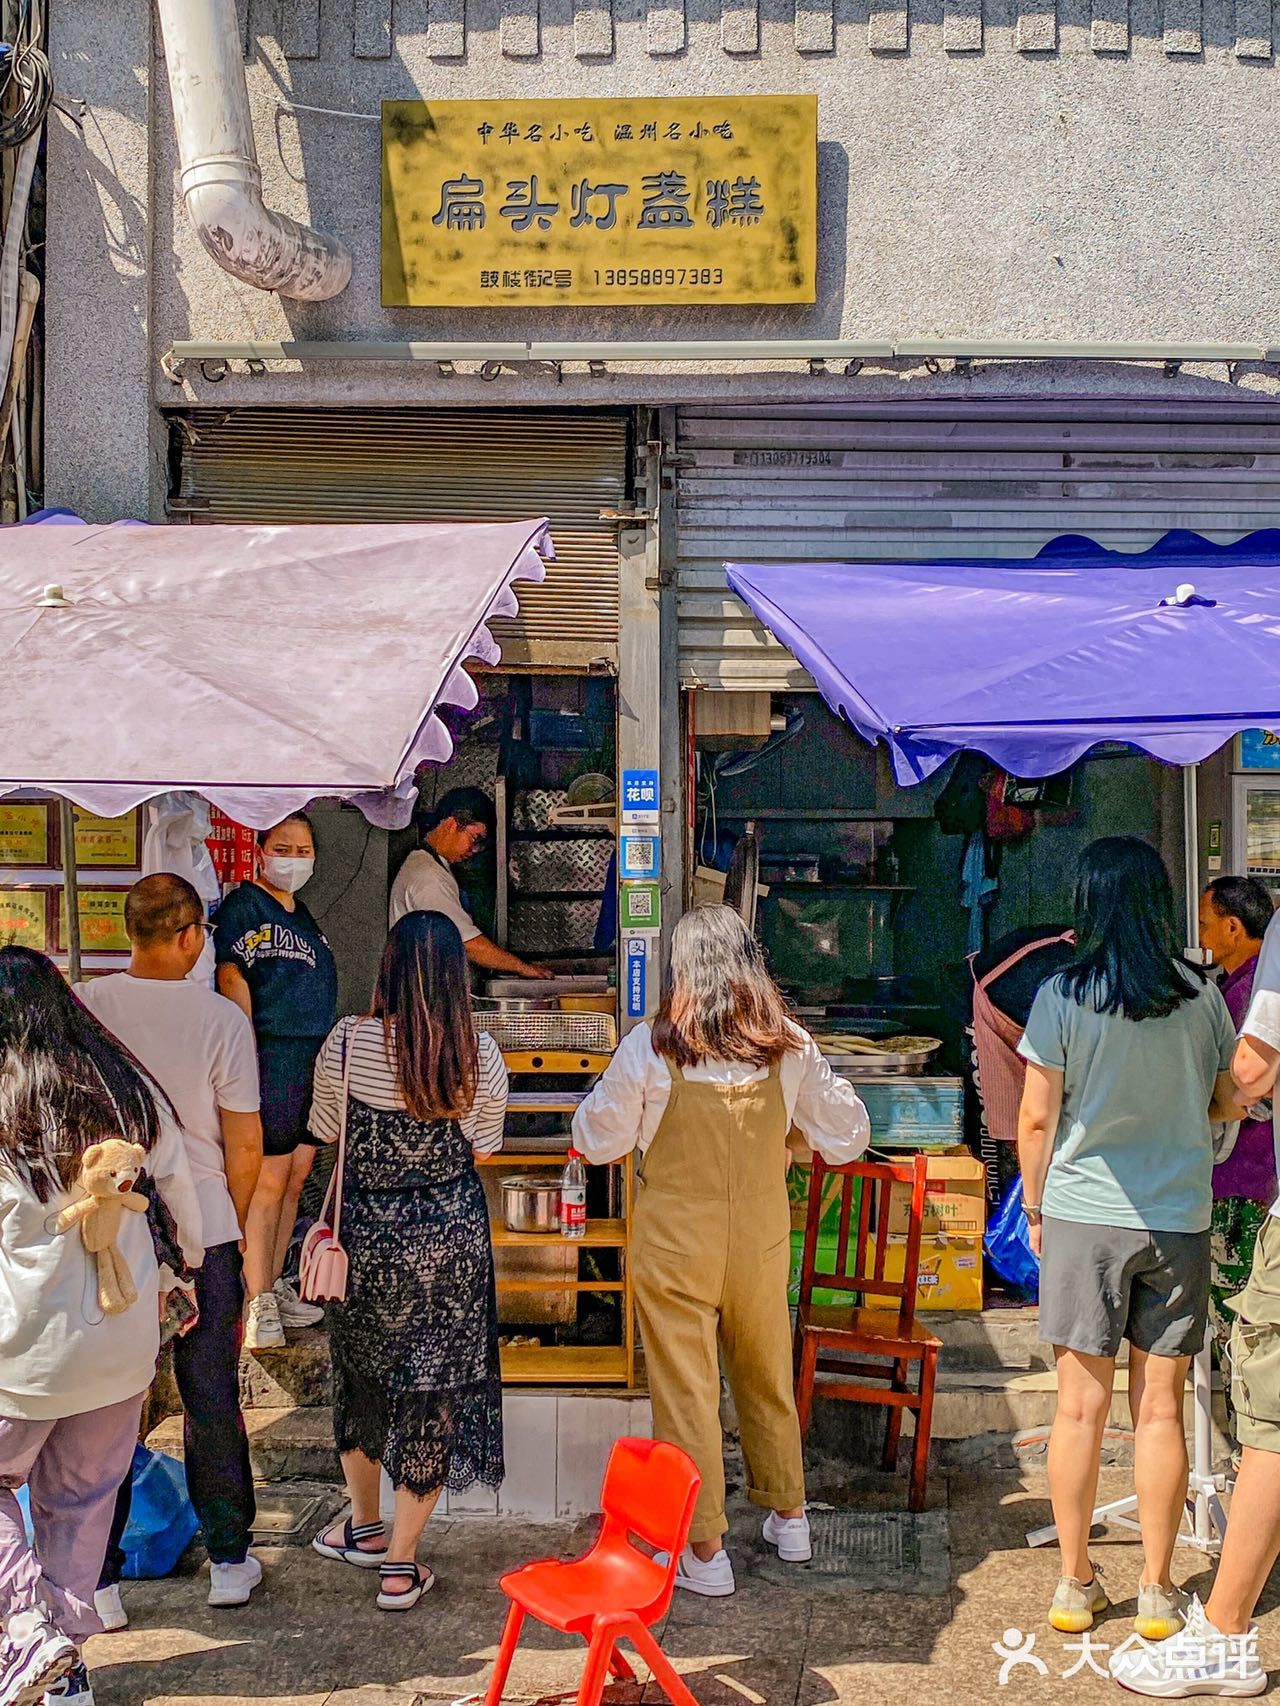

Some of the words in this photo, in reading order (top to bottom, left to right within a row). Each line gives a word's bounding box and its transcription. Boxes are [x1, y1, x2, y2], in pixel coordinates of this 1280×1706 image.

[477, 121, 595, 145] 中华名小吃
[614, 119, 735, 142] 温州名小吃
[432, 170, 764, 232] 扁头灯盏糕
[593, 268, 724, 286] 13858897383
[626, 787, 655, 802] 花呗
